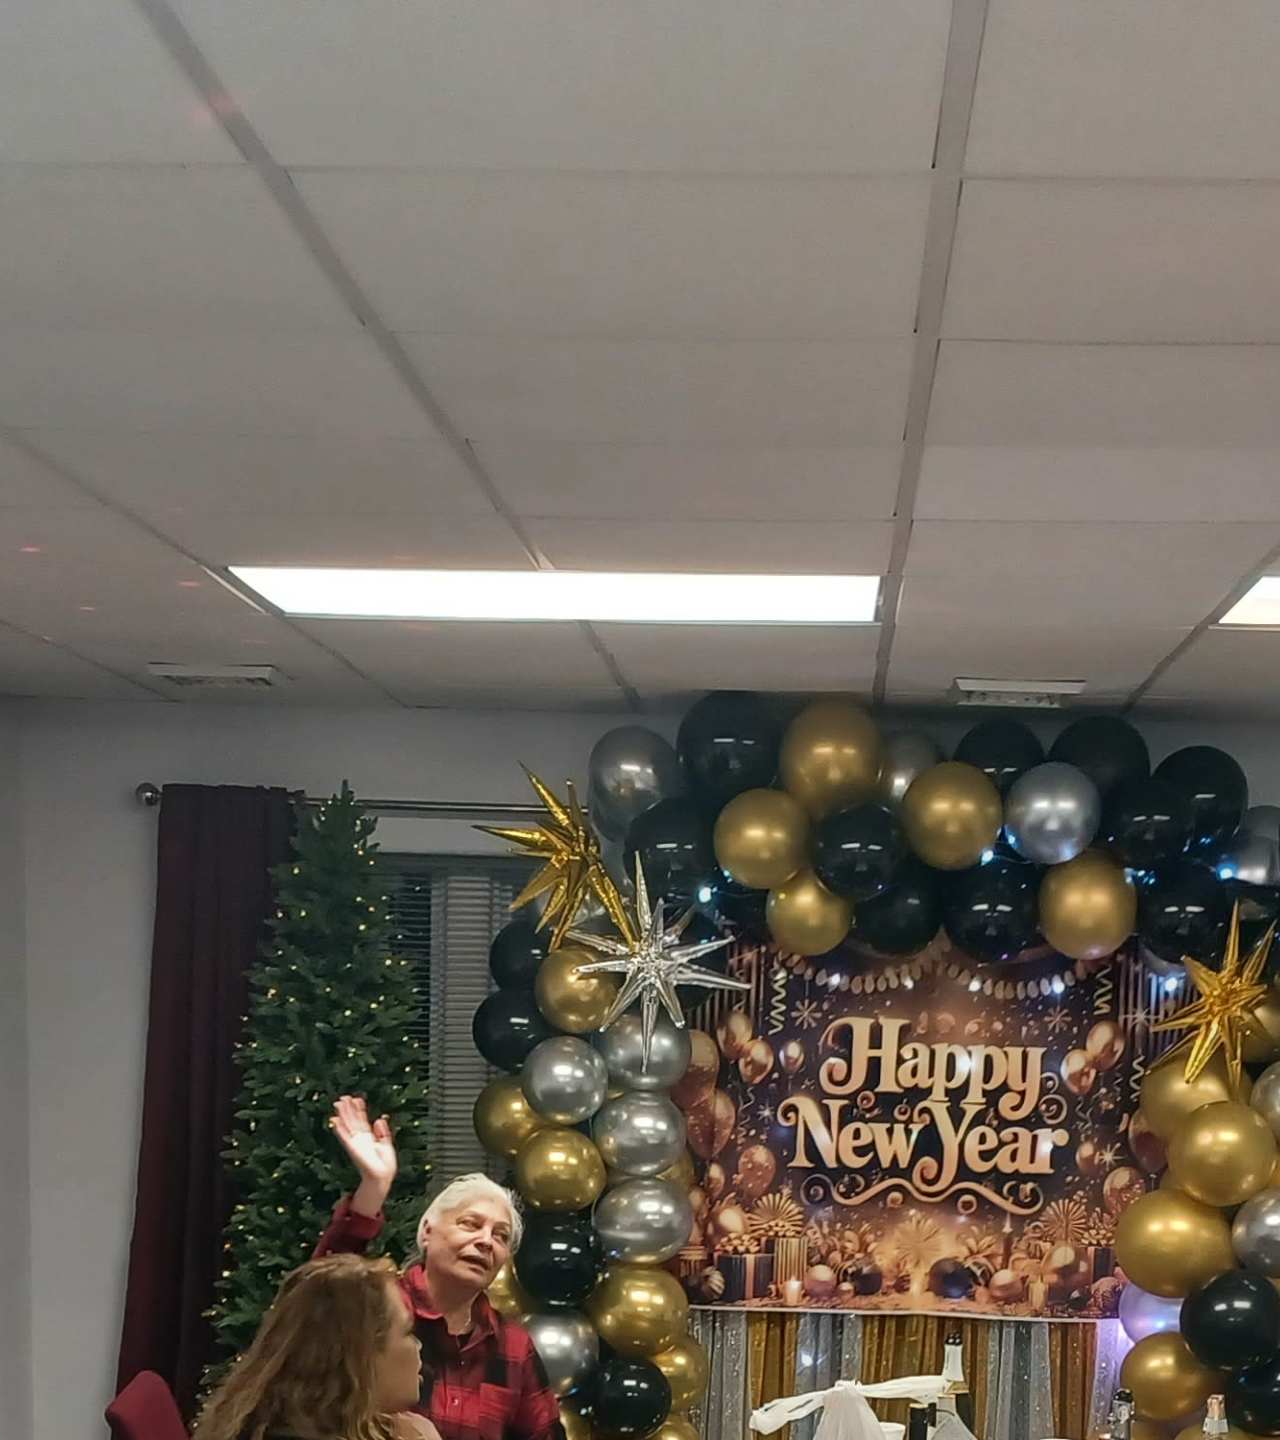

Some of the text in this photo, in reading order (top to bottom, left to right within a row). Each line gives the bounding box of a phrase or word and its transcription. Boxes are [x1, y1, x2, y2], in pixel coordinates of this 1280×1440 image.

[819, 1015, 1048, 1121] Happy
[777, 1096, 1069, 1193] New Year
